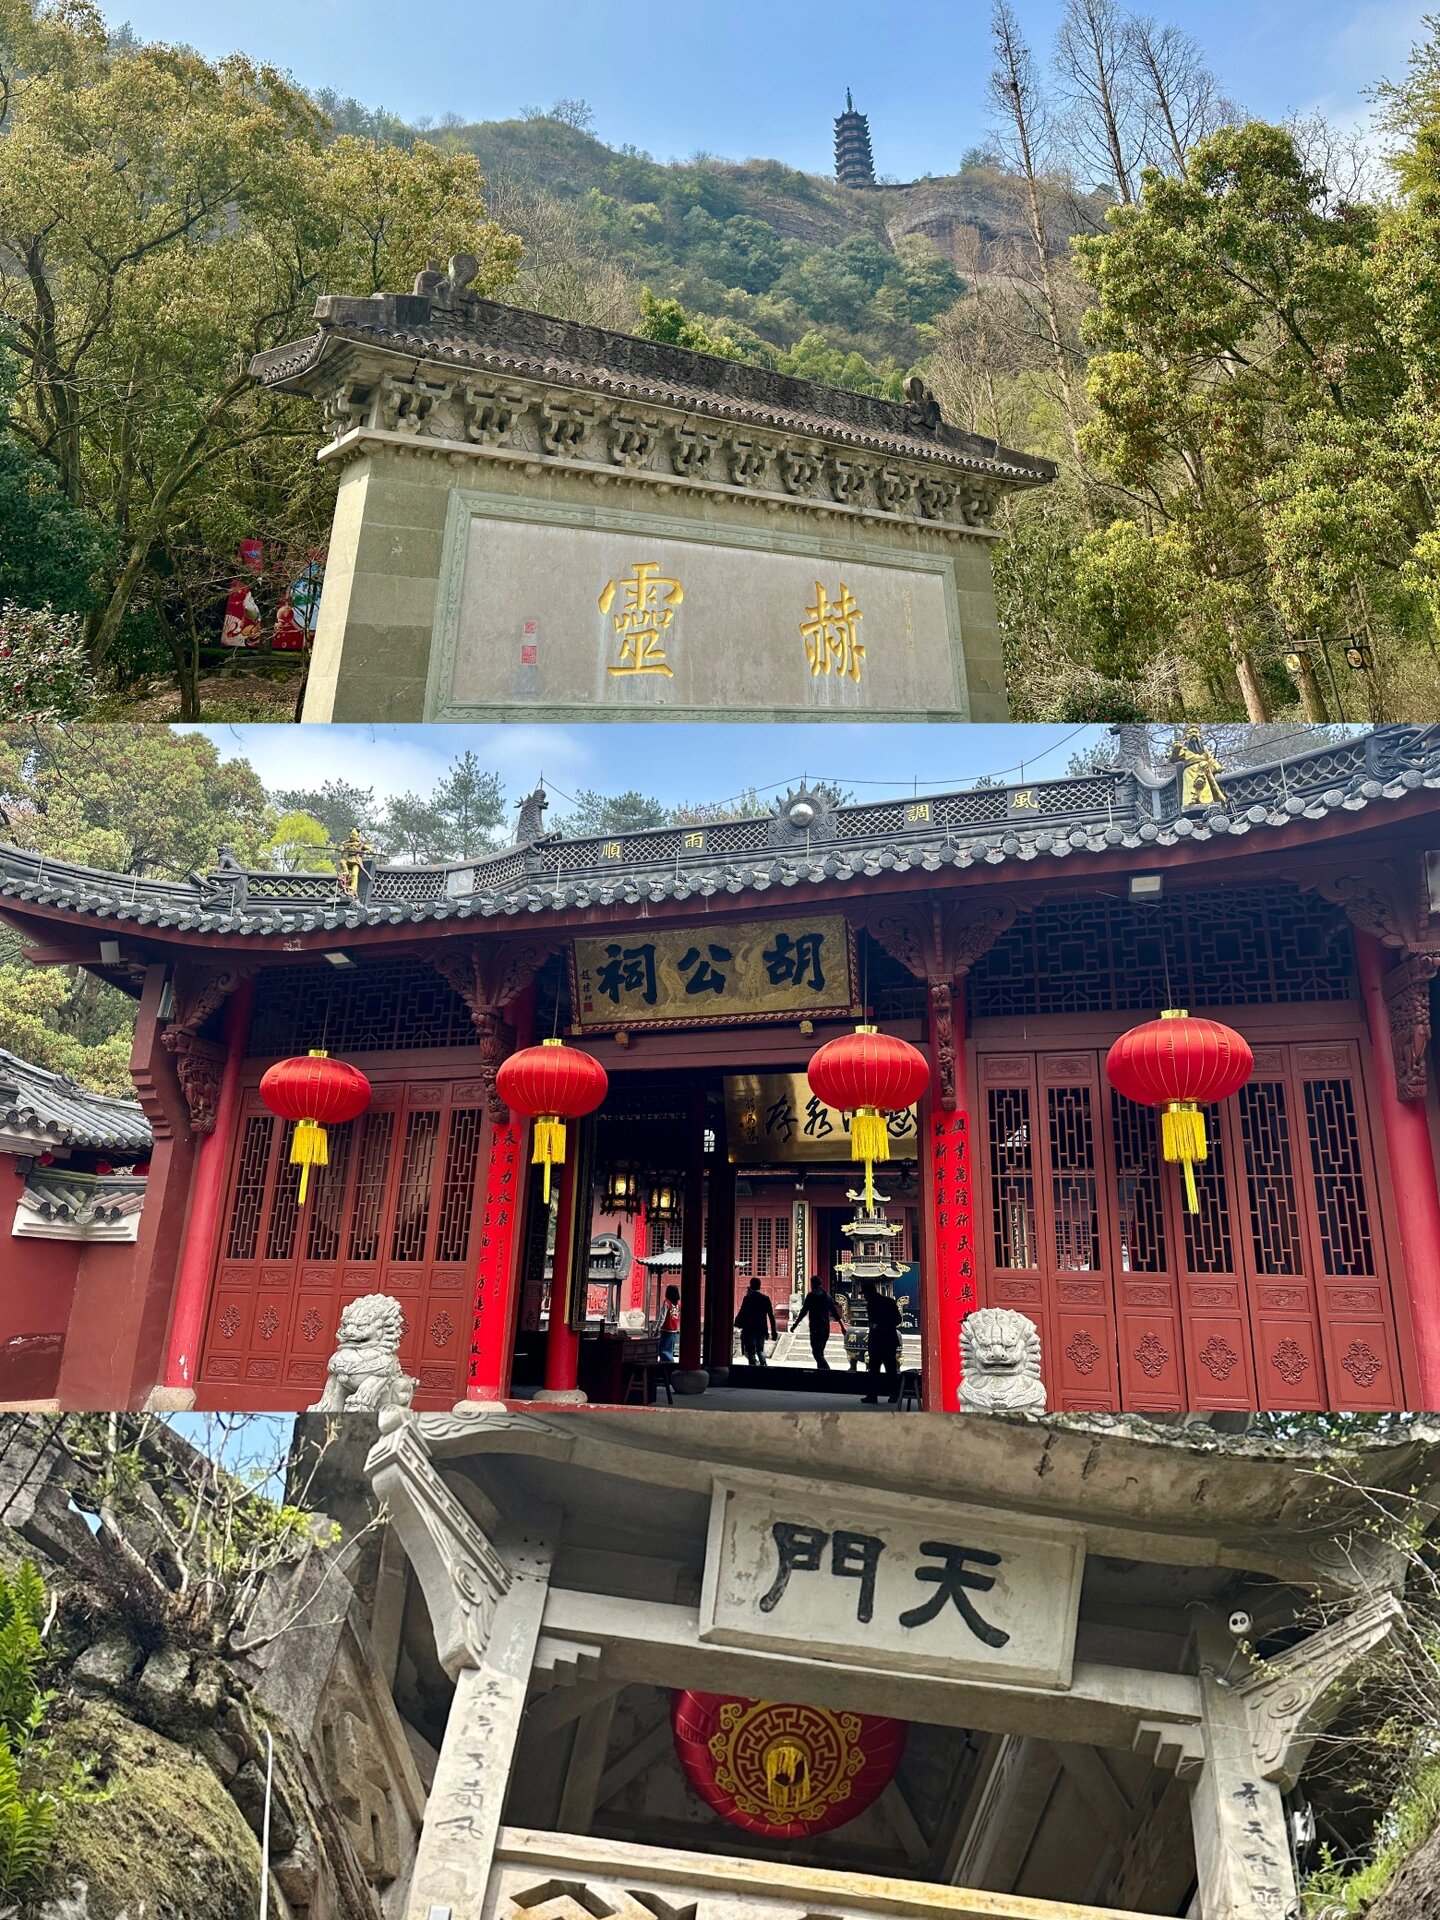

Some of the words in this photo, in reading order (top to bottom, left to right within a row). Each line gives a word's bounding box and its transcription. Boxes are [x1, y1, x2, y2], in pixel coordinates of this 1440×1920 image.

[598, 561, 866, 683] 赫靈
[596, 933, 825, 1004] 胡公祠
[759, 1521, 1010, 1649] 天門
